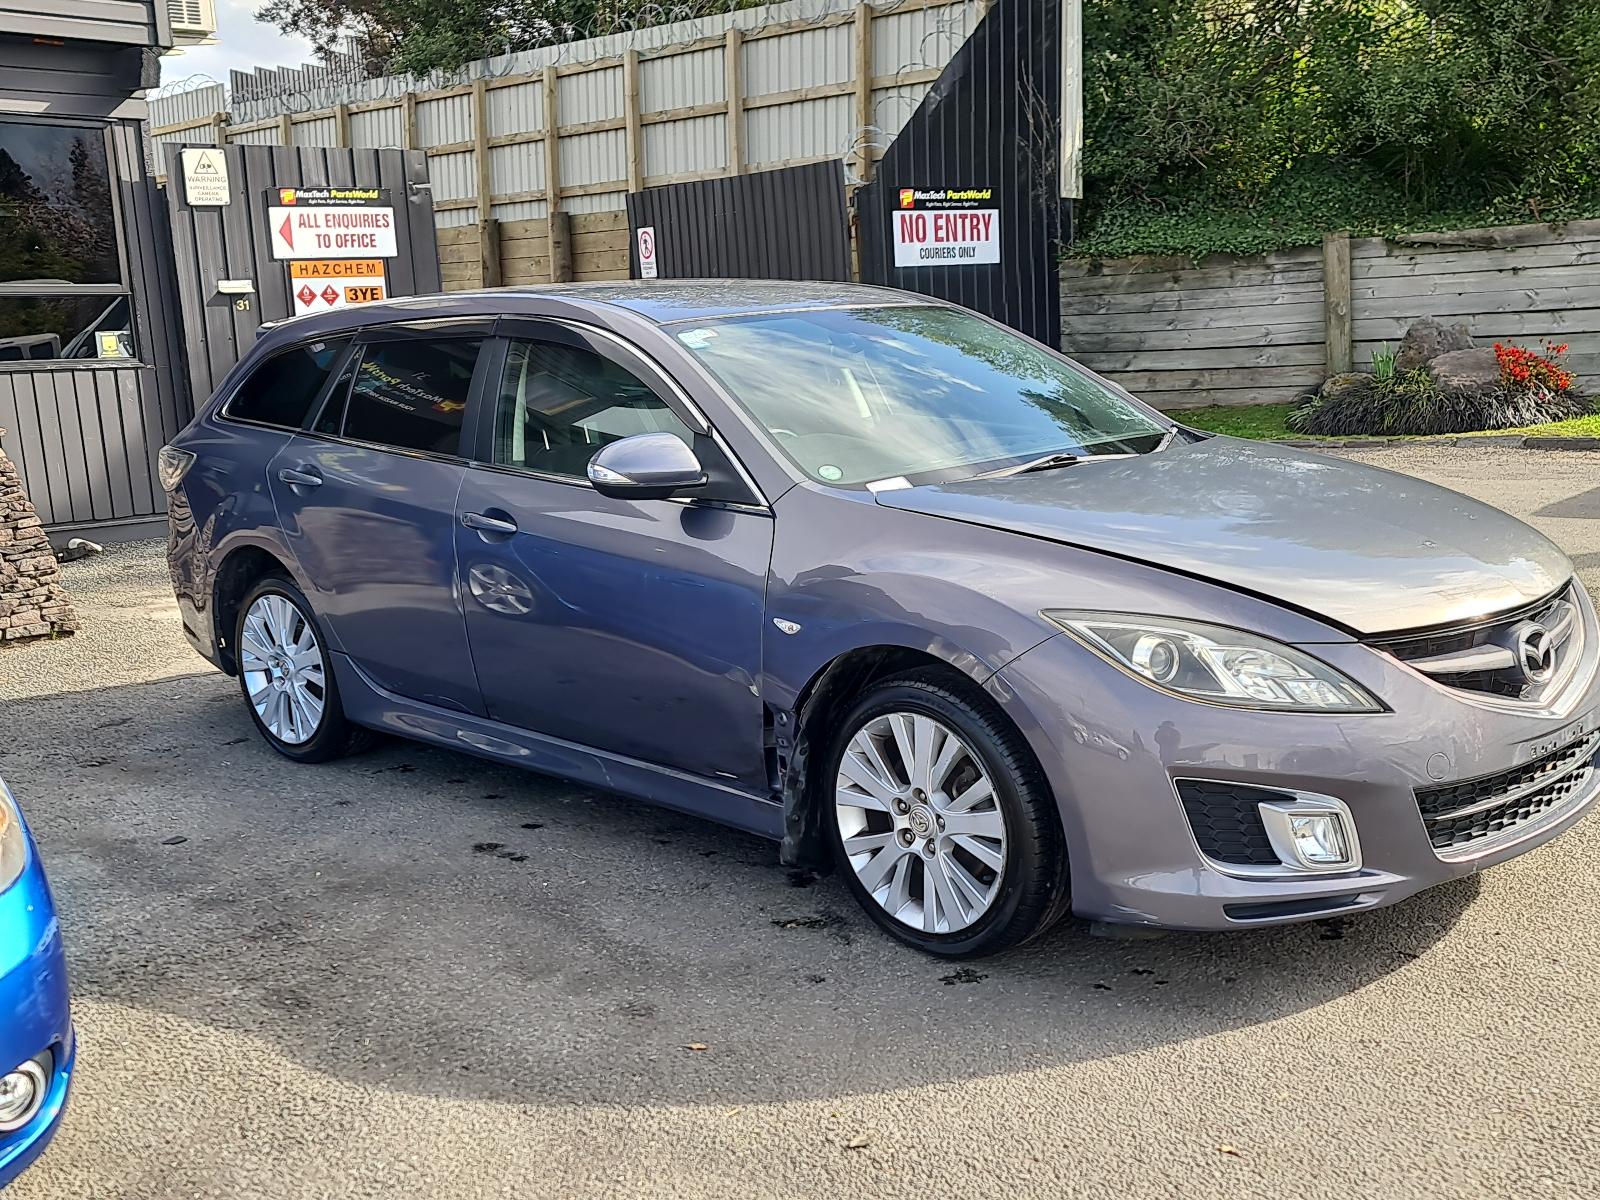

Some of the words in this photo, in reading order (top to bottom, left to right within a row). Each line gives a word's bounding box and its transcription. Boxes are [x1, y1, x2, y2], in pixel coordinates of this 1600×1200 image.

[187, 175, 227, 183] WARNING
[296, 189, 330, 198] MaxTech
[330, 189, 379, 199] PartsWorld
[914, 190, 946, 200] MaxTech
[946, 189, 992, 200] PartsWorld
[298, 213, 320, 228] ALL
[324, 213, 390, 229] ENQUIRIES
[900, 213, 927, 243] NO
[933, 213, 992, 243] ENTRY
[315, 233, 331, 248] TO
[335, 233, 377, 248] OFFICE
[920, 247, 956, 259] COURIERS
[958, 246, 977, 258] ONLY
[299, 263, 377, 275] HAZCHEM
[349, 287, 380, 301] 3YE
[236, 300, 250, 311] 31
